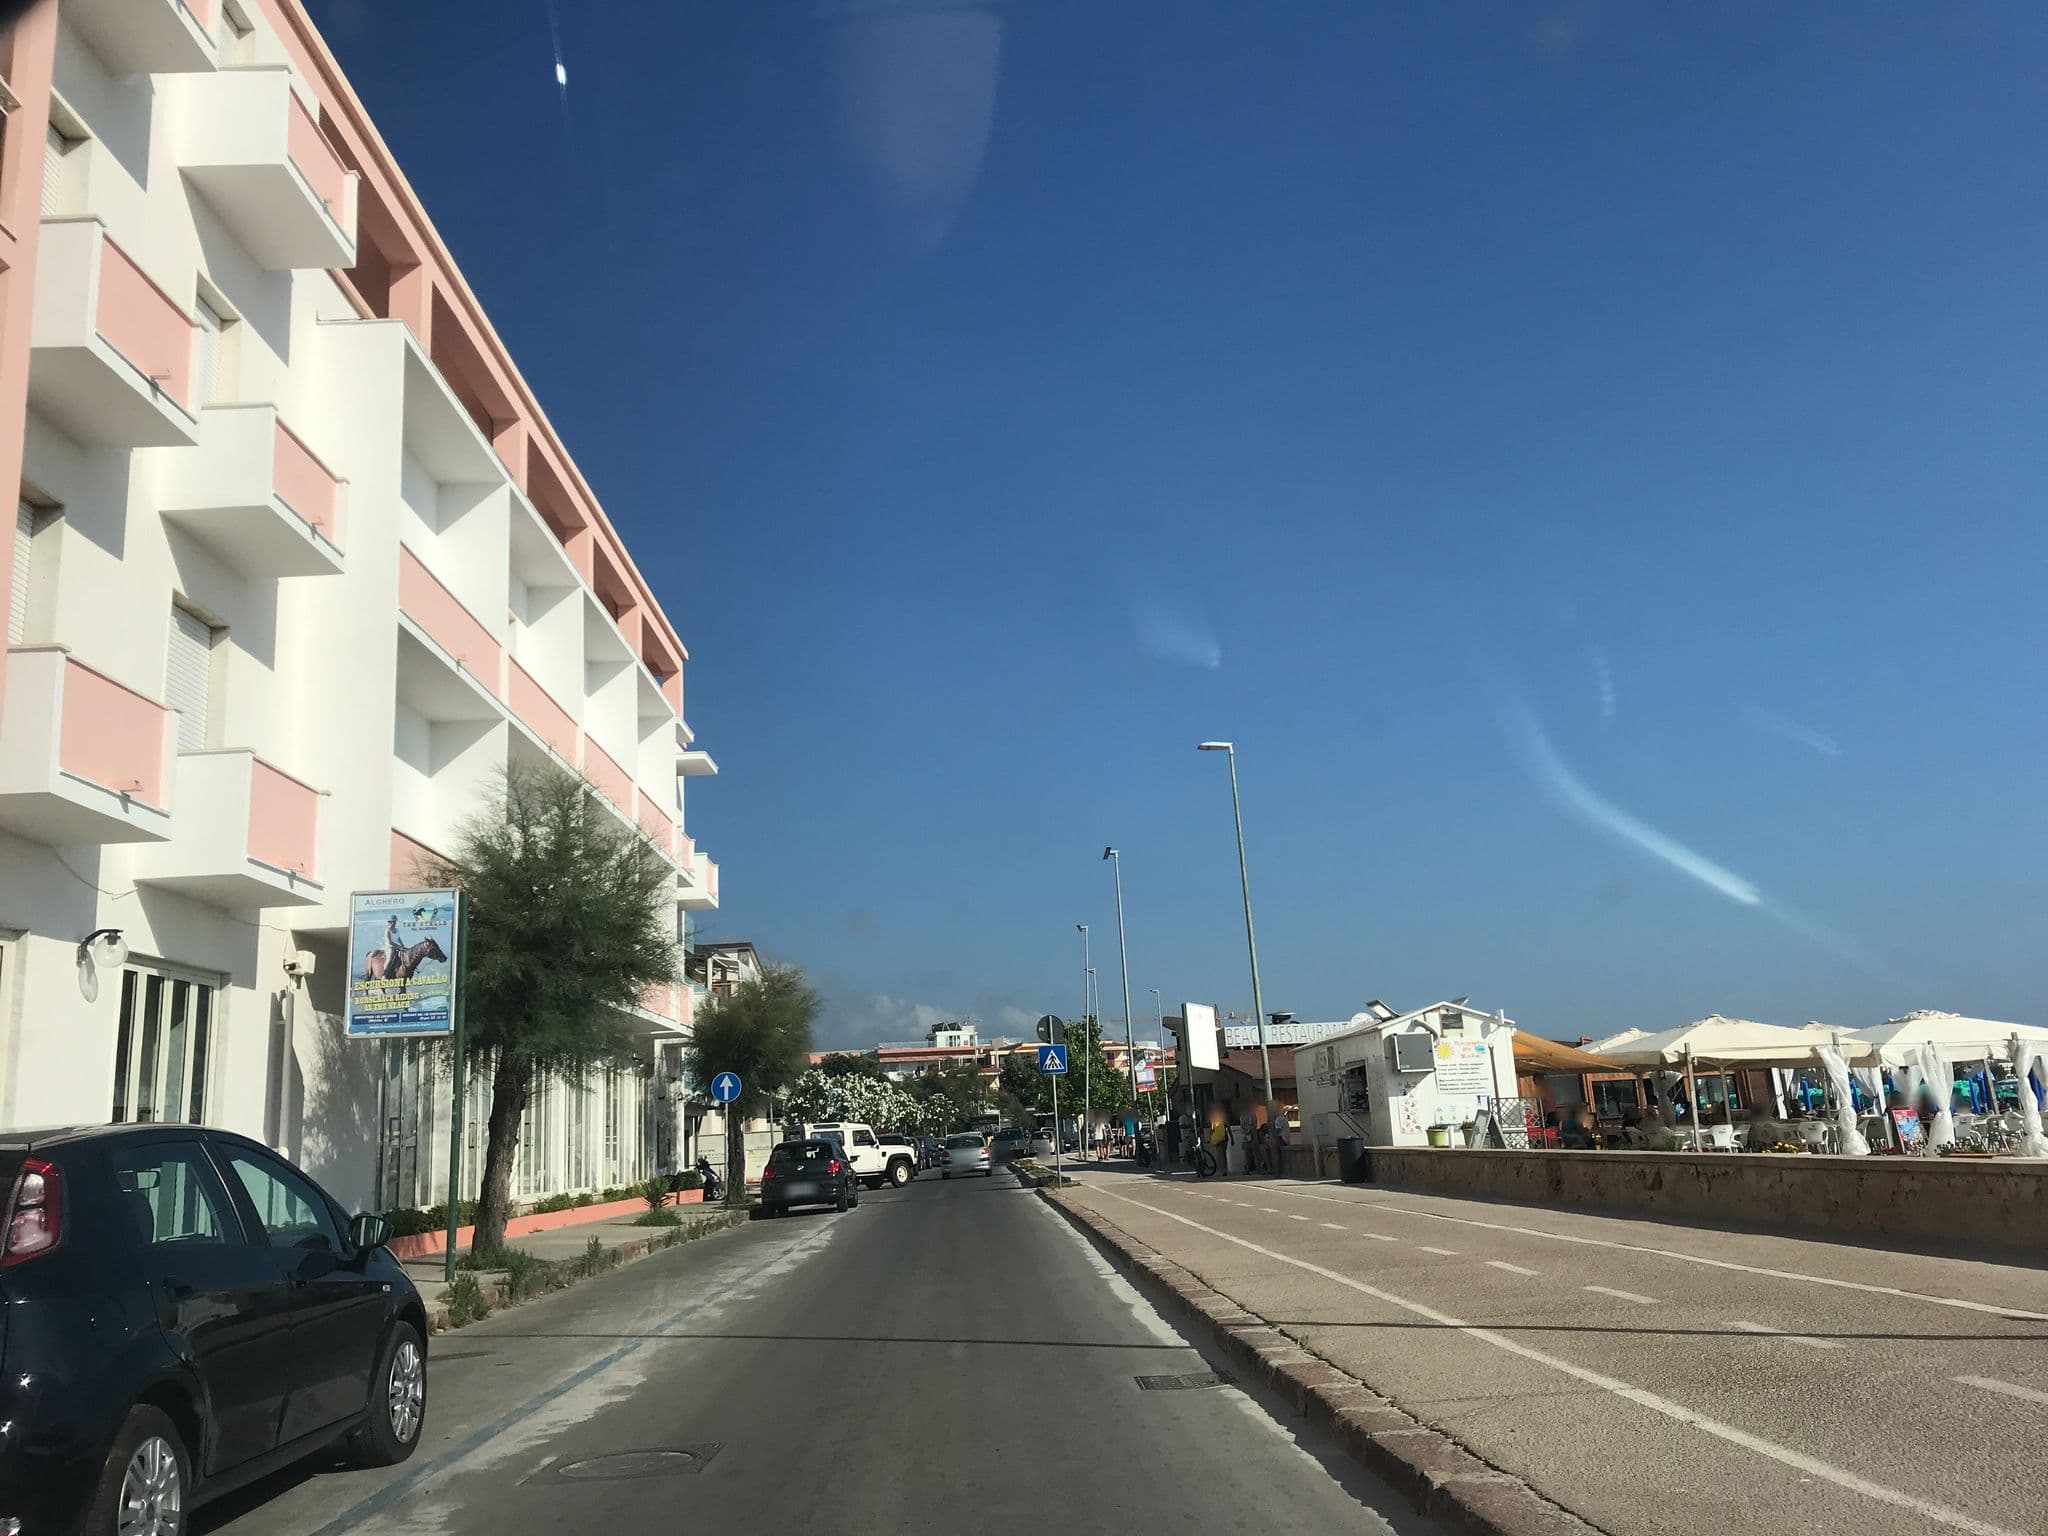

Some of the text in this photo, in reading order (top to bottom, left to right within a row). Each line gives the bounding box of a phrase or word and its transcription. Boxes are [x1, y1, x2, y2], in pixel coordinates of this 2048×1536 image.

[365, 898, 405, 906] ALGHERO
[354, 978, 404, 991] ESCURSIONI
[412, 975, 448, 986] CAVALLO
[354, 994, 394, 1005] HORSEBACK
[395, 992, 419, 1001] RIDING
[1226, 1026, 1263, 1046] BEAC
